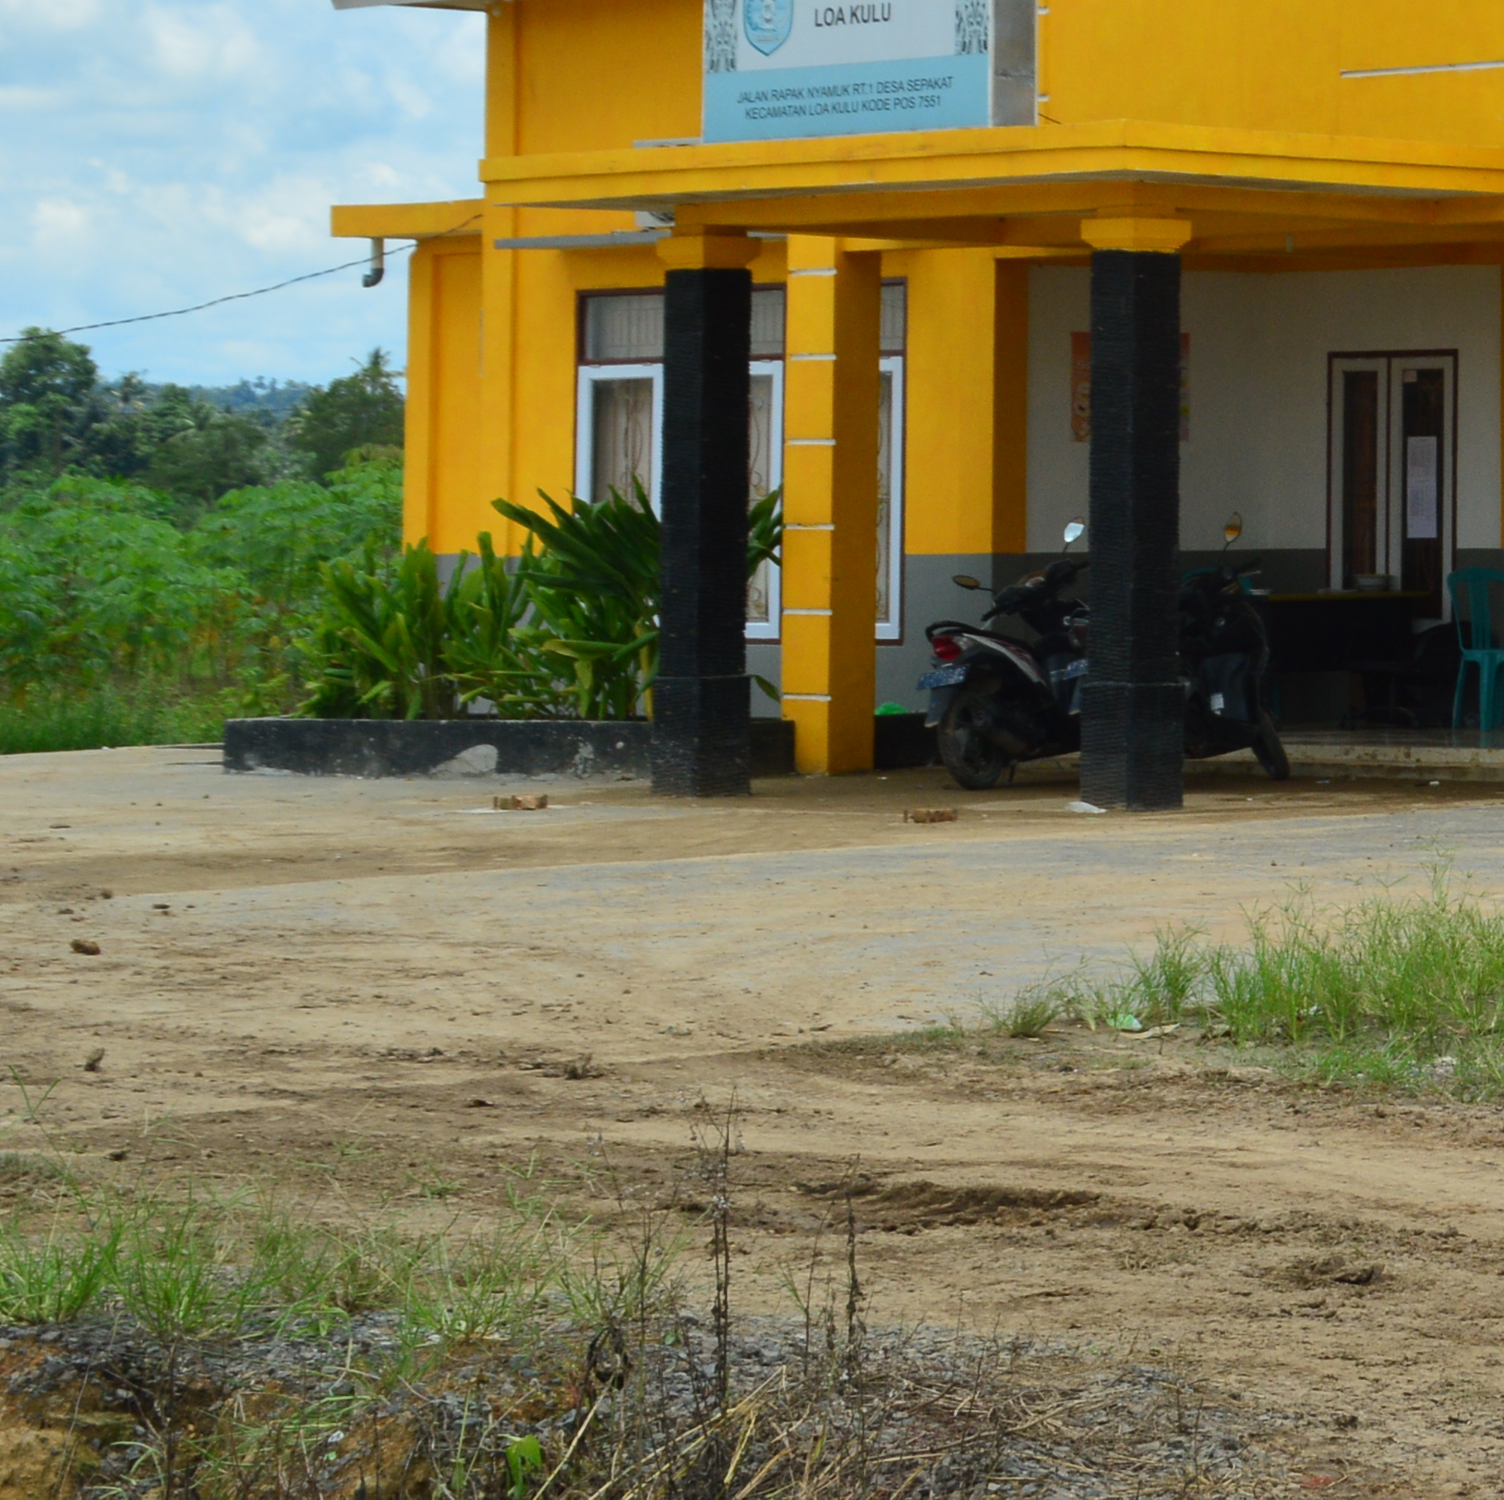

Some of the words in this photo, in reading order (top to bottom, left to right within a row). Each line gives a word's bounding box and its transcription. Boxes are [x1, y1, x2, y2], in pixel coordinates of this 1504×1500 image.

[815, 5, 846, 27] LOA
[850, 2, 891, 24] KULU
[737, 90, 769, 104] JALAN
[771, 87, 804, 101] RAPAK
[807, 84, 851, 100] NYAMUK
[876, 80, 905, 94] DESA
[906, 76, 954, 92] SEPAKAT
[745, 103, 808, 120] KECAMATAN
[809, 102, 830, 116] LOA
[831, 100, 859, 114] KULU
[861, 98, 891, 112] KODE
[893, 96, 916, 110] POS
